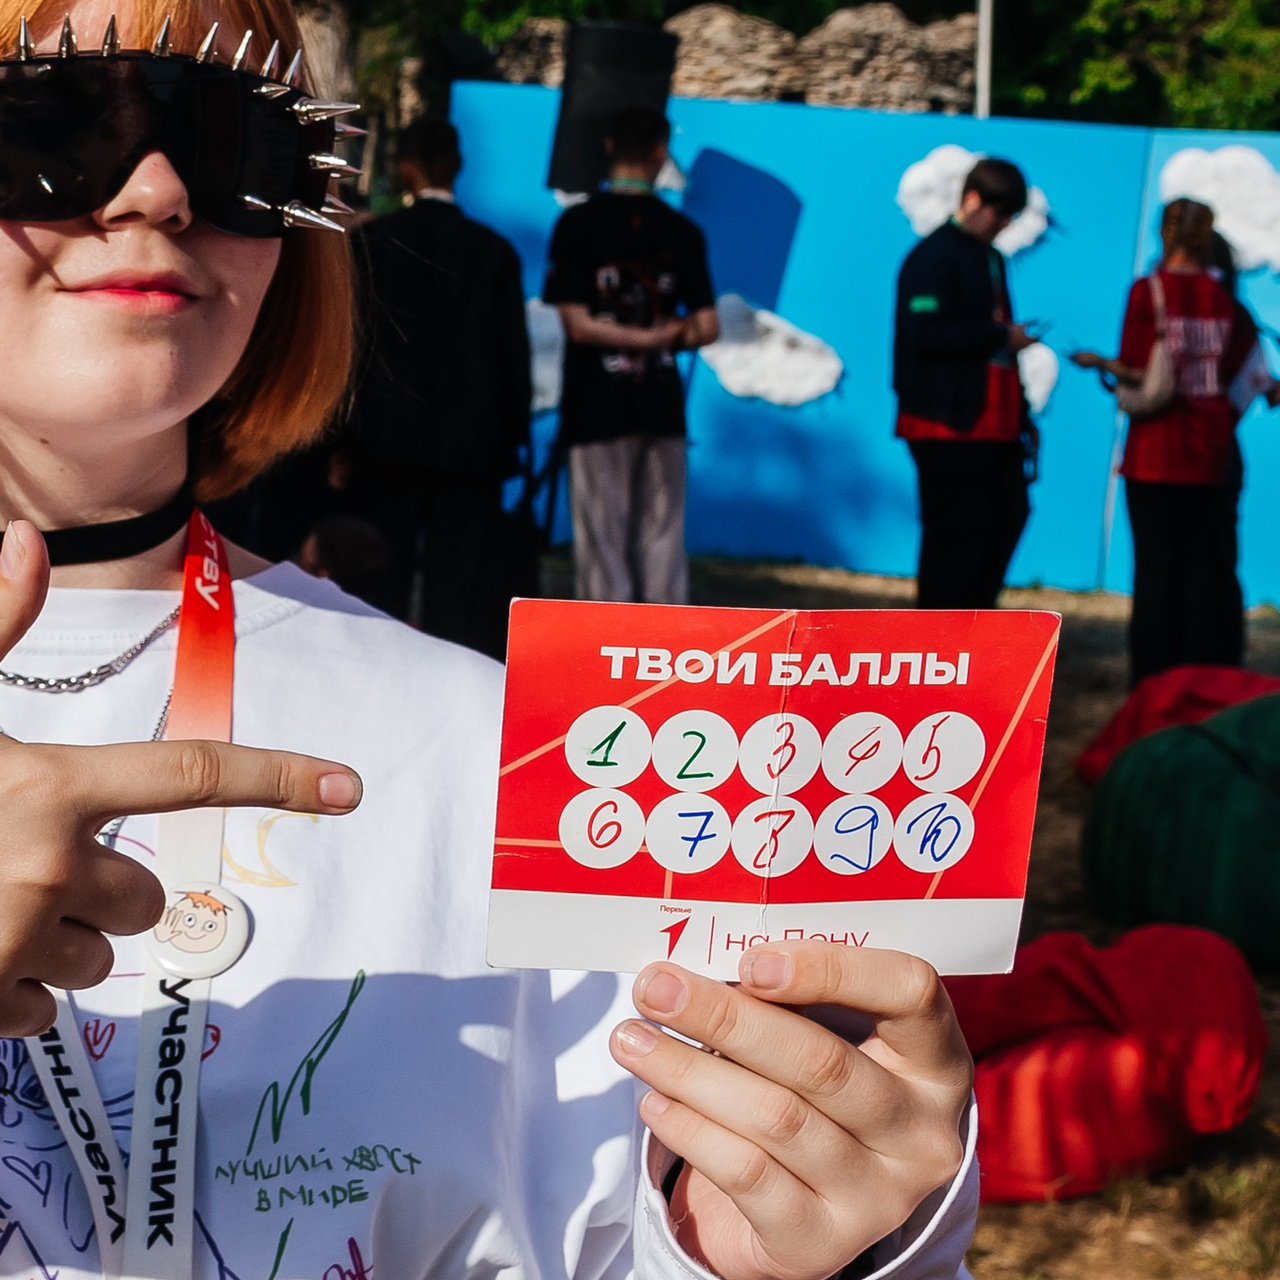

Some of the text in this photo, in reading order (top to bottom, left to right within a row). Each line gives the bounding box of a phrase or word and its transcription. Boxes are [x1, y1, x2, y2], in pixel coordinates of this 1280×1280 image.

[599, 646, 970, 687] ТВОИ БАЛЛЫ
[586, 715, 951, 780] 1 2 3 4 5
[587, 801, 622, 849] 6
[677, 811, 717, 858] 7
[830, 805, 879, 871] 9
[907, 802, 961, 861] 10
[659, 905, 692, 914] Первые
[146, 978, 193, 1250] участник
